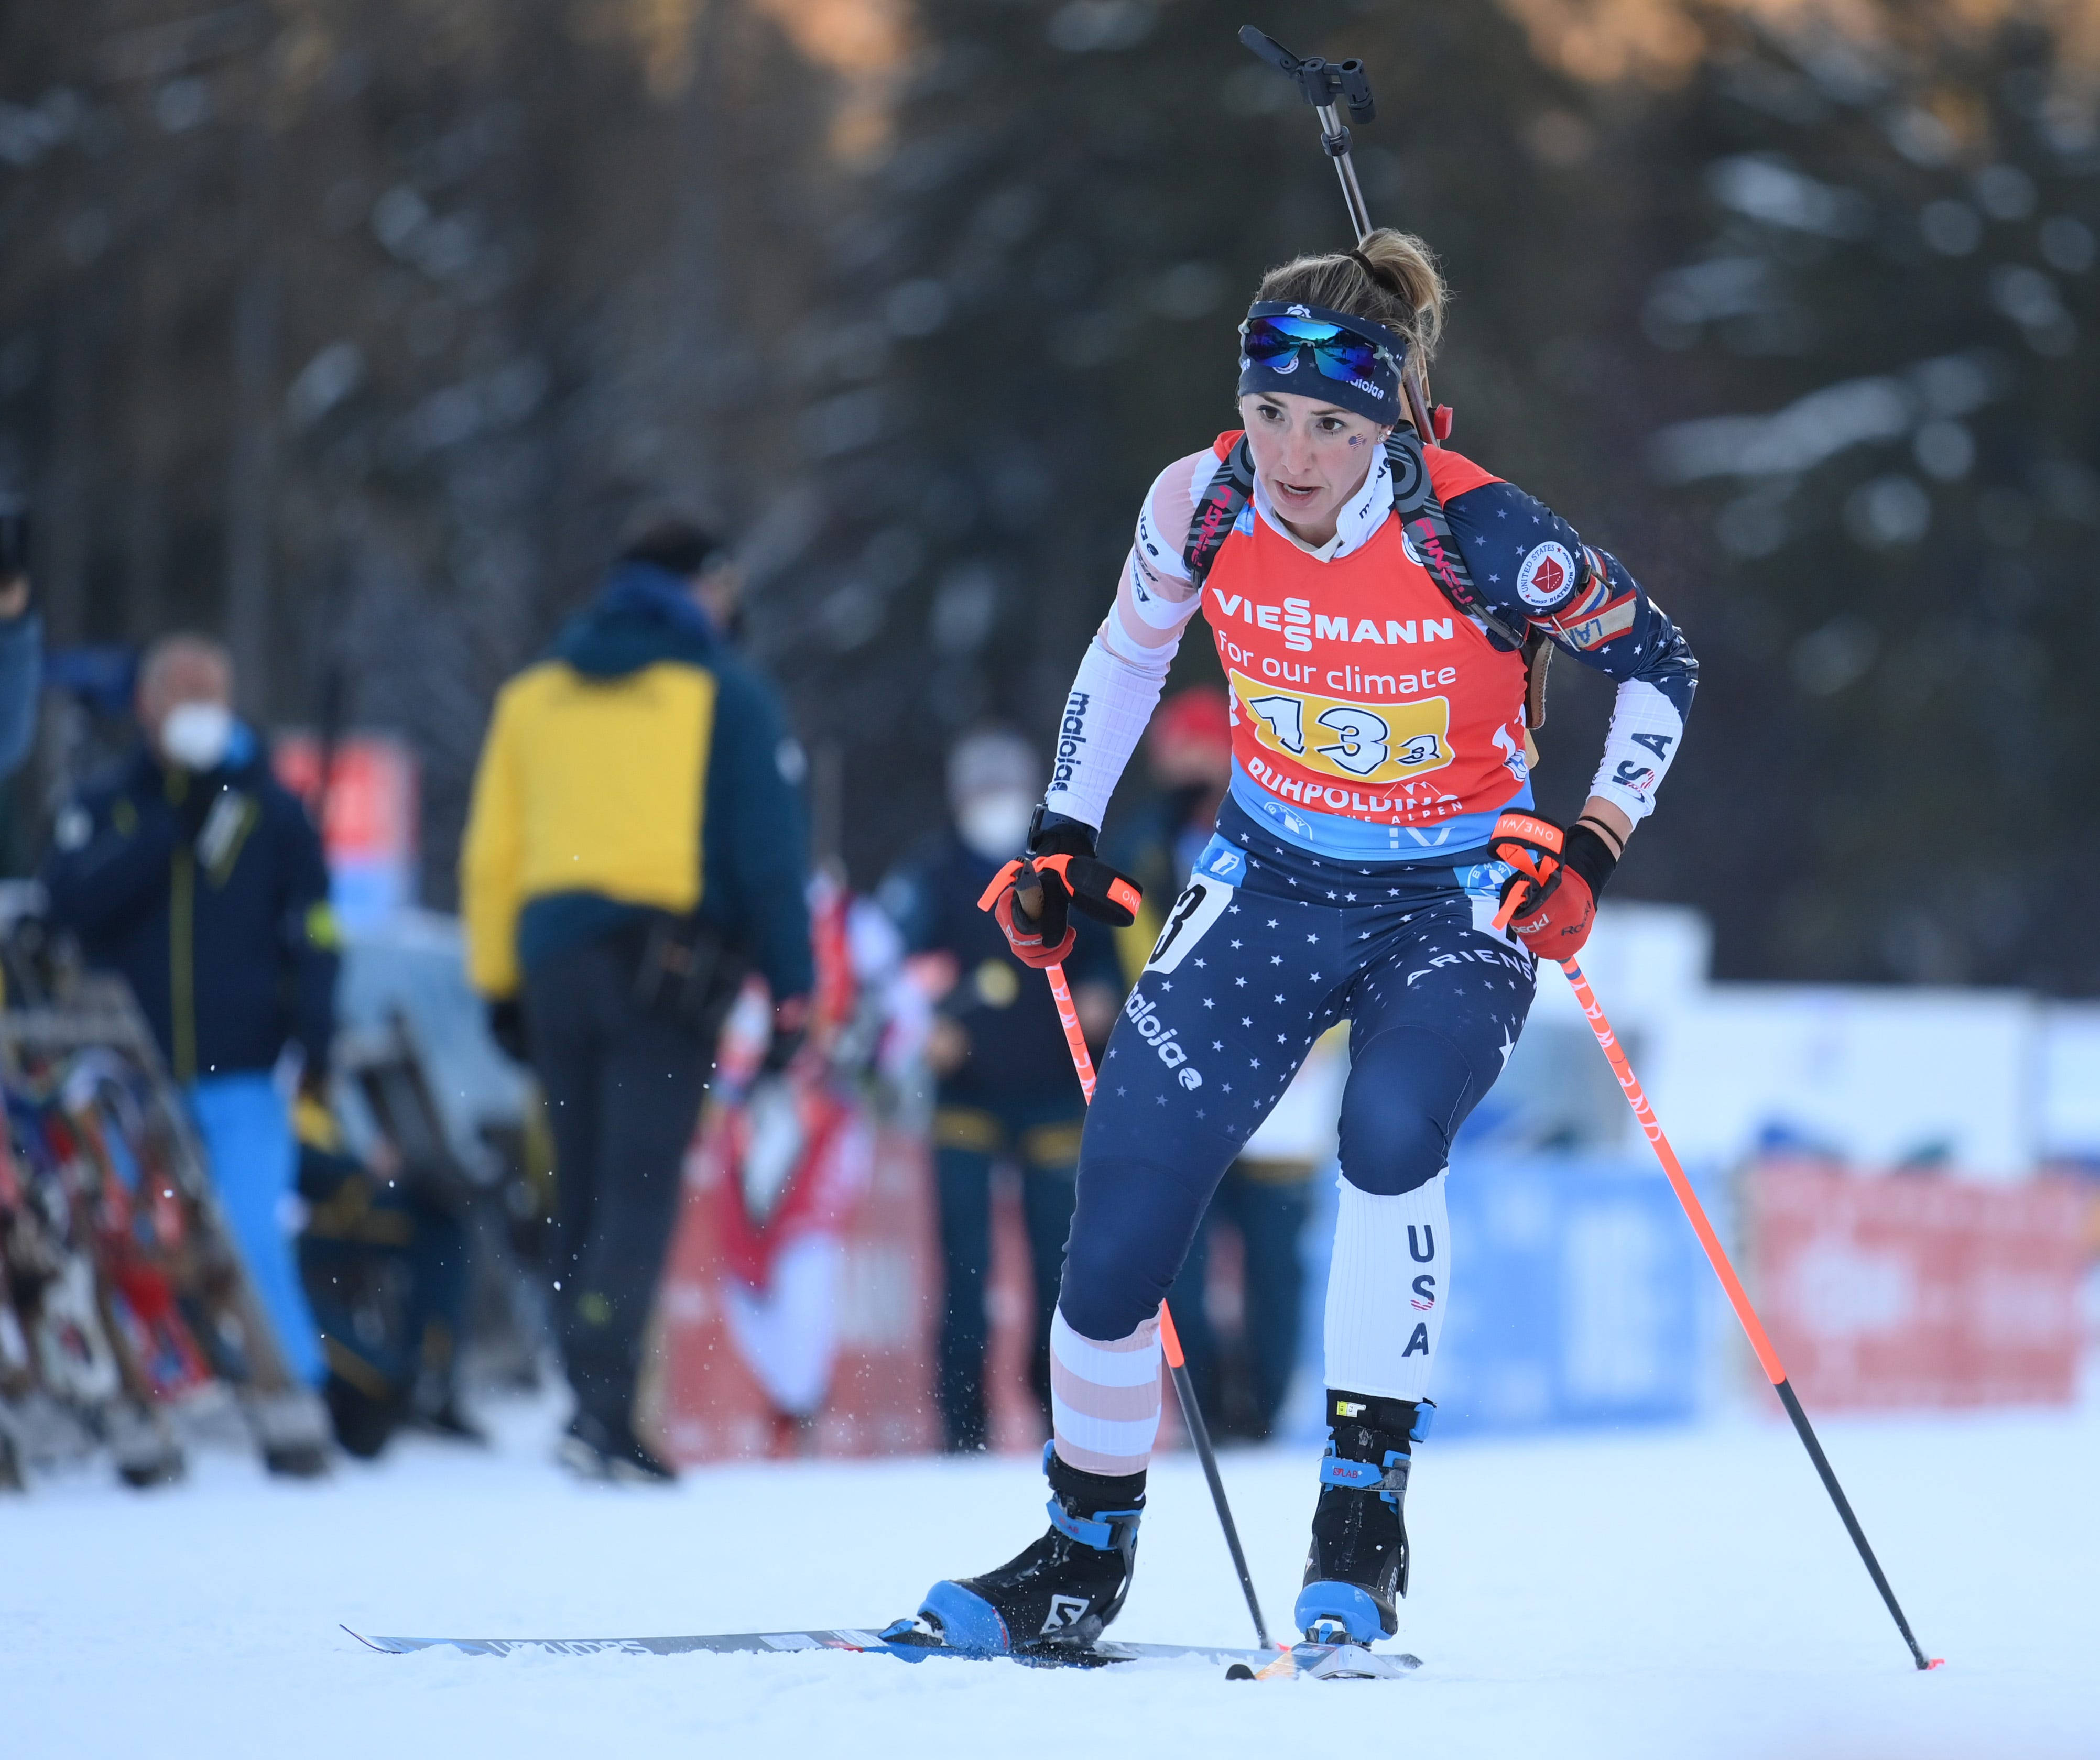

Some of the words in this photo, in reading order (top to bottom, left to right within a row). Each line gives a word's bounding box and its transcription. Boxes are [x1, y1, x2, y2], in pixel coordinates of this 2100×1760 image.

[1521, 561, 1532, 593] UNITED
[1532, 544, 1555, 561] STATES
[1549, 572, 1574, 603] BIATHLON
[1212, 588, 1454, 652] VIESSMANN
[1218, 630, 1254, 668] For
[1262, 657, 1317, 684] our
[1326, 665, 1456, 695] climate
[1053, 692, 1090, 781] maloja
[1249, 696, 1388, 775] 13
[1395, 735, 1442, 766] 3
[1612, 733, 1673, 803] USA
[1391, 801, 1463, 824] ALPEN
[1472, 862, 1508, 879] BMW
[1401, 1225, 1436, 1358] USA
